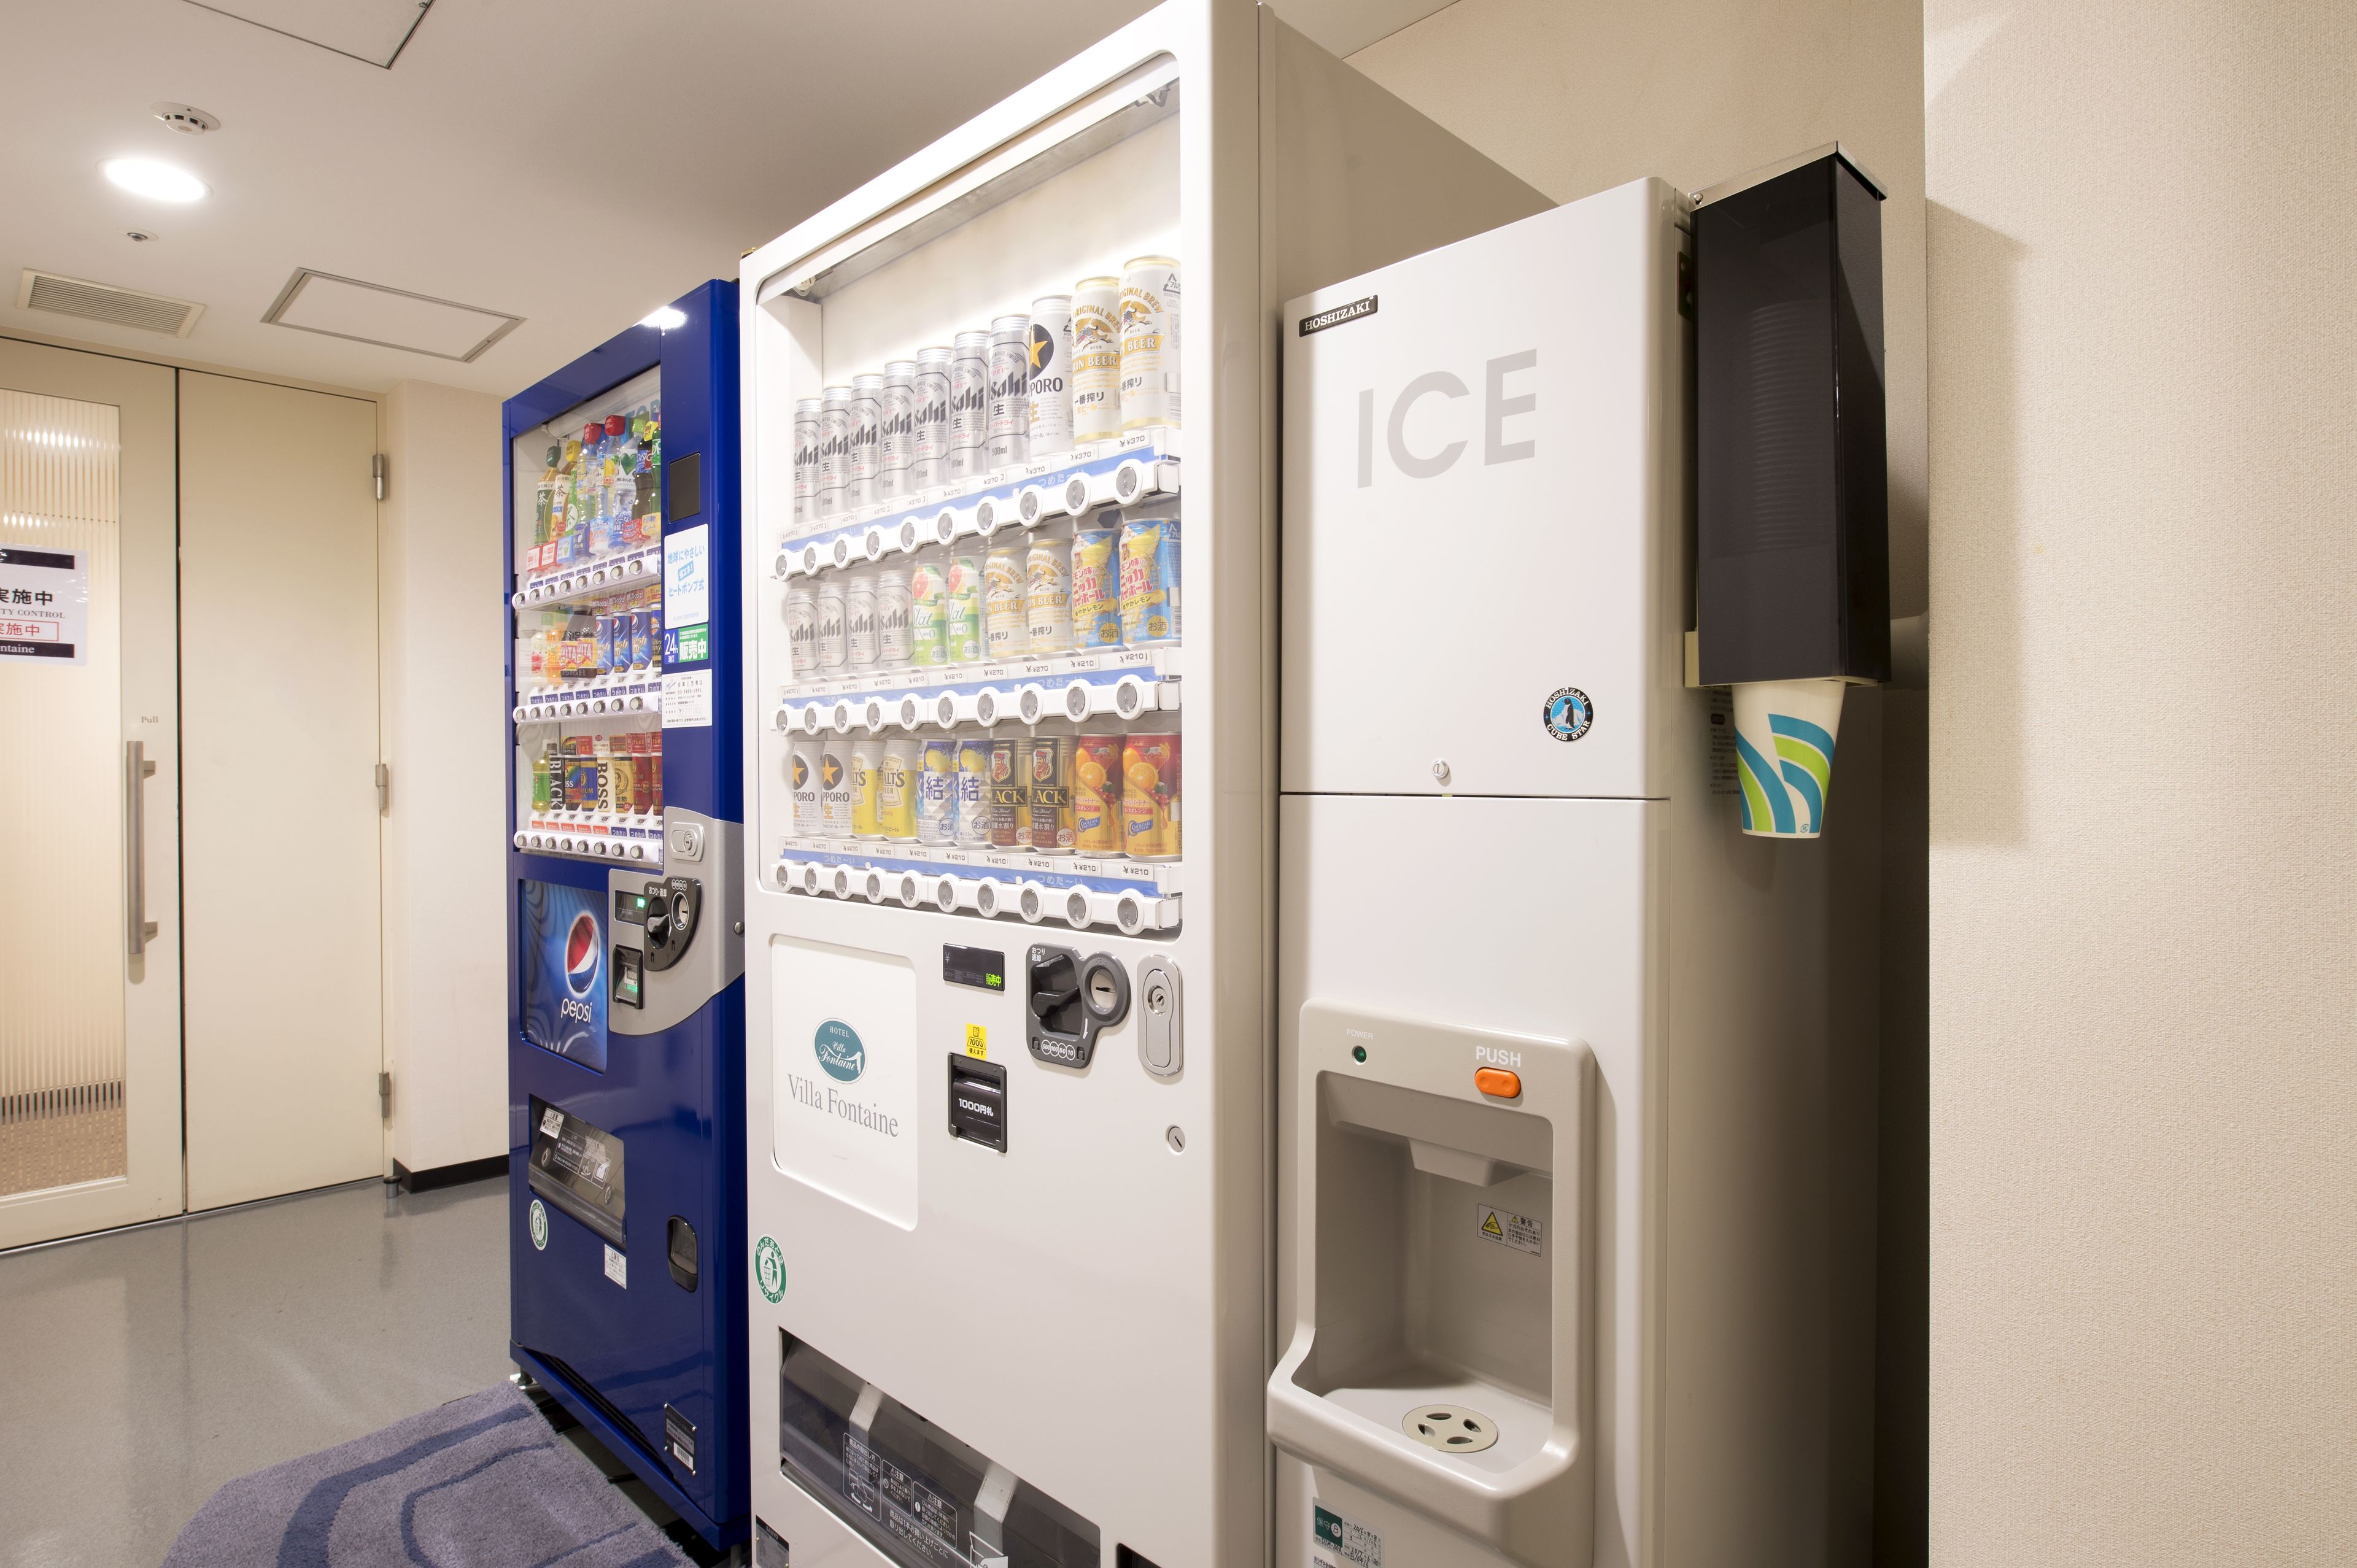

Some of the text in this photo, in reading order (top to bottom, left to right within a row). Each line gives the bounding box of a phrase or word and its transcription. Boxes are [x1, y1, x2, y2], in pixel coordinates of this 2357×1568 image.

[1143, 293, 1164, 314] BREW
[1304, 300, 1371, 331] HOSHIZAKI
[1128, 338, 1156, 351] BEER
[1088, 355, 1118, 368] BEER
[1120, 376, 1142, 392] 番搾り
[1074, 392, 1104, 405] 一番搾り
[993, 403, 1005, 416] 生
[953, 417, 962, 430] 生
[1357, 348, 1537, 489] ICE
[916, 430, 926, 442] 生
[992, 445, 1007, 457] 500ml
[1075, 451, 1091, 460] ¥370
[667, 545, 705, 564] 地球にやさしい
[1051, 559, 1070, 577] BREW
[668, 579, 705, 597] ヒートポンプ式
[994, 602, 1018, 612] BEER
[1038, 595, 1062, 606] BEER
[18, 609, 66, 619] CONTROL
[0, 623, 41, 637] 施中
[1101, 628, 1119, 638] お酒
[1148, 622, 1167, 631] お酒
[883, 634, 892, 644] 生
[989, 631, 1008, 642] 番搾り
[679, 638, 706, 660] 販売中
[931, 649, 948, 659] お酒
[963, 644, 980, 654] お酒
[1546, 687, 1590, 709] HOSHIZAKI
[1546, 719, 1591, 741] CUBE STAR
[549, 759, 563, 809] BLACK
[597, 762, 608, 809] BOSS
[926, 776, 944, 800] 結
[961, 776, 980, 801] 結
[973, 821, 989, 830] お酒
[1058, 832, 1074, 842] お酒
[1031, 947, 1046, 956] おつり
[985, 973, 1002, 987] 販売中
[561, 998, 592, 1024] pepsi
[829, 1025, 850, 1038] HOTEL
[972, 1025, 980, 1037] 新
[1346, 1029, 1374, 1040] POWER
[832, 1041, 846, 1053] Villa
[969, 1038, 984, 1048] 1000
[818, 1045, 857, 1072] Fontaine
[969, 1048, 985, 1057] 使えます
[1476, 1045, 1522, 1067] PUSH
[788, 1073, 899, 1138] Villa Fontaine
[958, 1097, 994, 1117] 1000円札
[1520, 1217, 1534, 1227] 警告
[1508, 1222, 1541, 1236] ケガのおそれあり
[756, 1237, 784, 1266] のんだあとは
[760, 1279, 784, 1303] リサイクル
[894, 1469, 904, 1483] 注意
[931, 1496, 943, 1509] 注意
